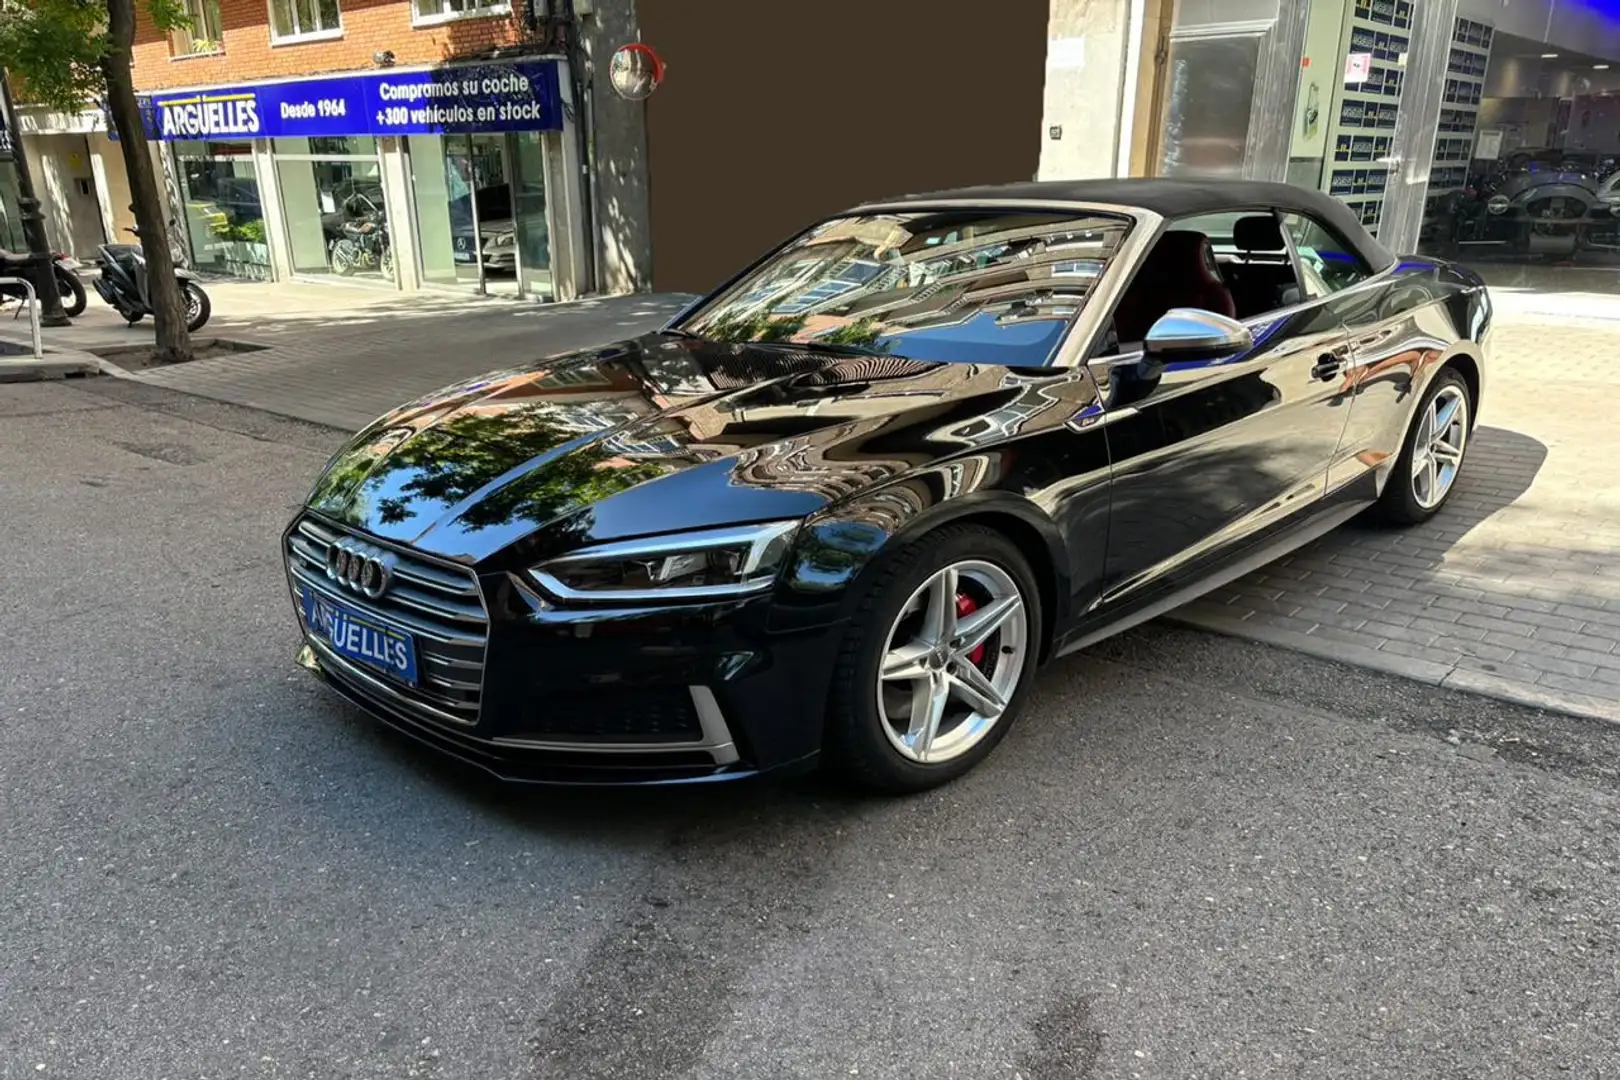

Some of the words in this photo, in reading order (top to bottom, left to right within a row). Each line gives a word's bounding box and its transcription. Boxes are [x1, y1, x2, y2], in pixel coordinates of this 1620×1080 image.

[379, 81, 459, 102] Compramos
[462, 81, 479, 95] su
[482, 74, 529, 95] coche
[163, 94, 259, 136] ARGÜELLES
[280, 100, 316, 119] Desde
[317, 98, 347, 117] 1964
[376, 106, 409, 126] +300
[410, 104, 474, 124] vehículos
[477, 108, 496, 122] en
[499, 100, 541, 120] stock
